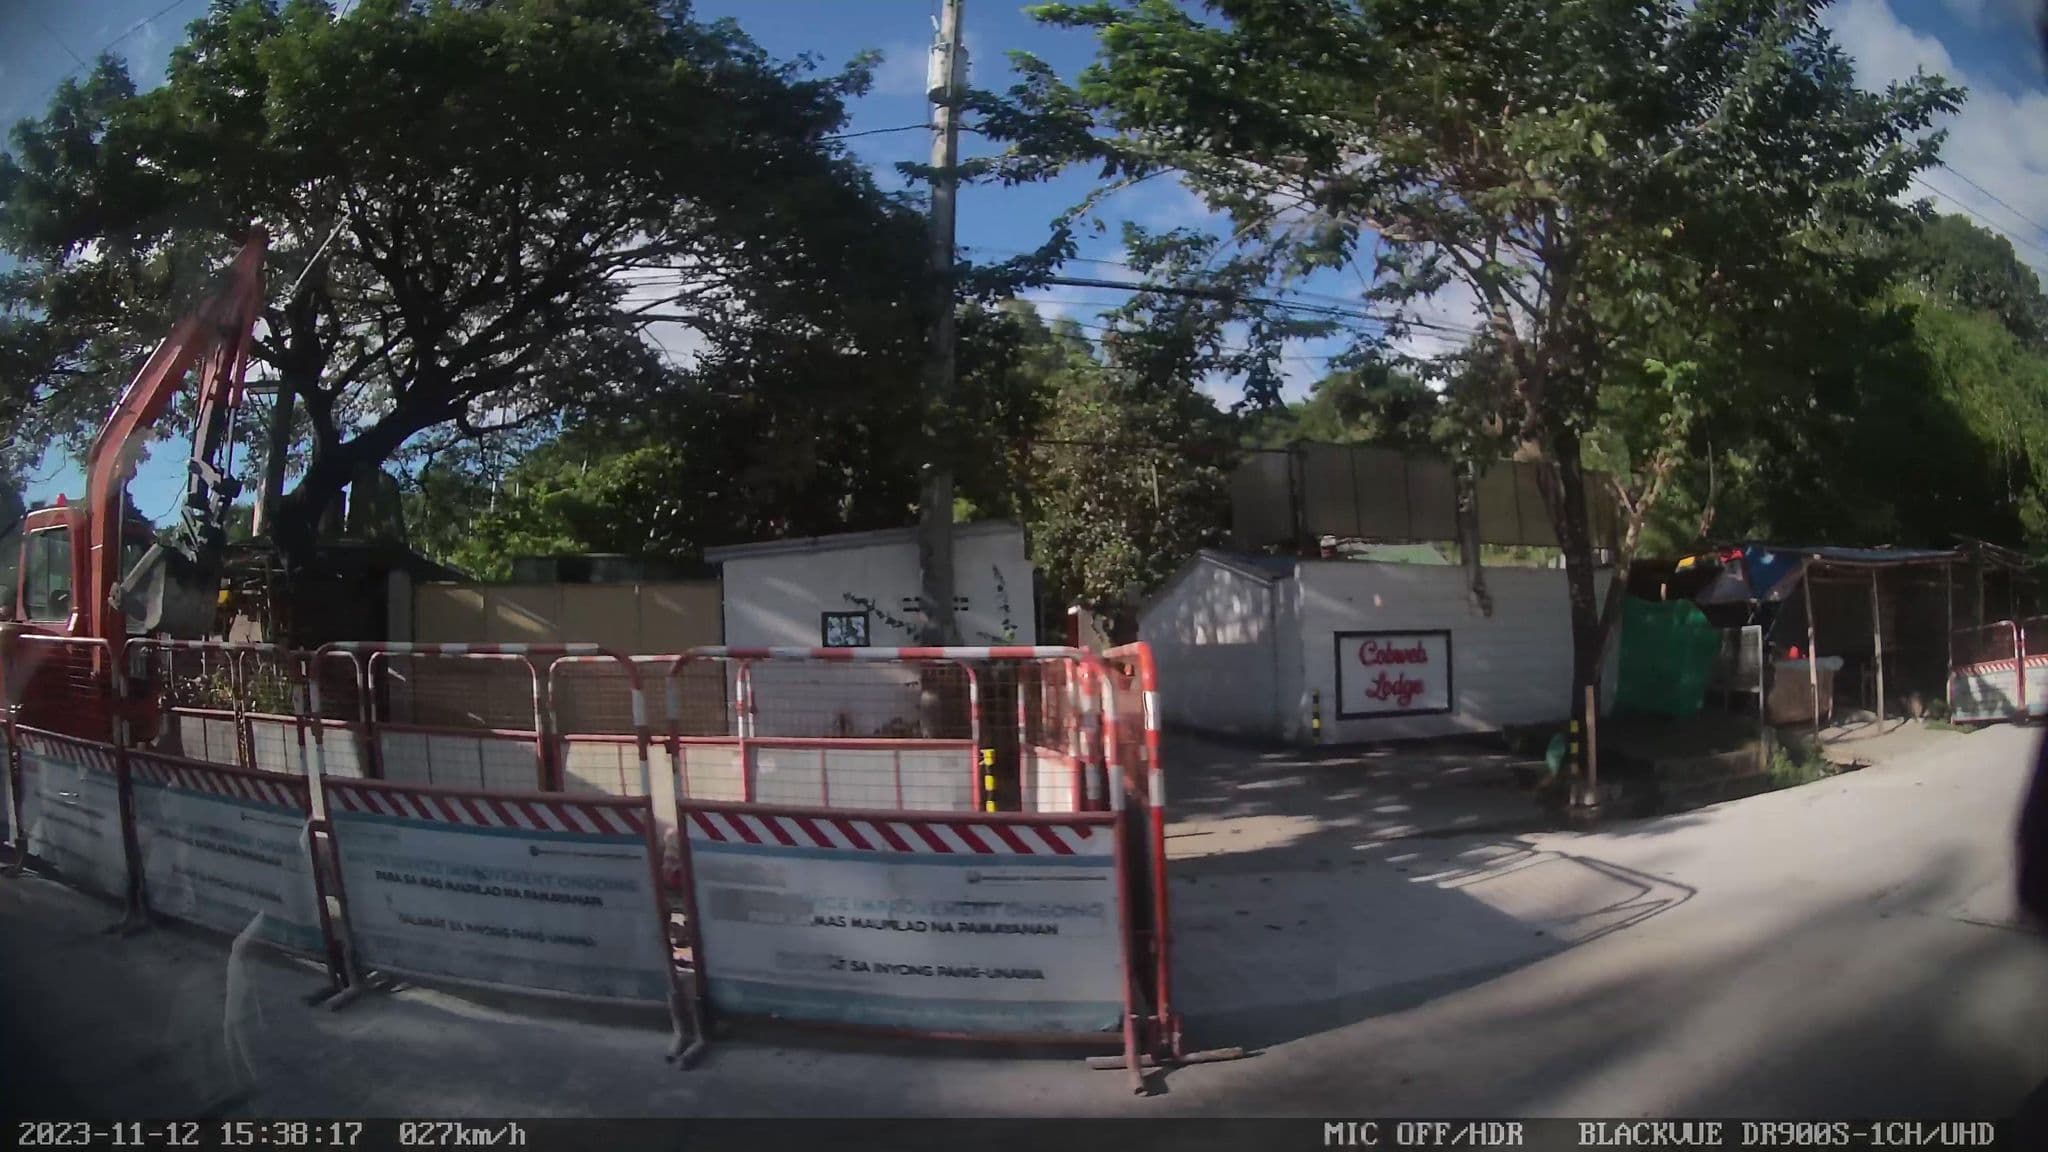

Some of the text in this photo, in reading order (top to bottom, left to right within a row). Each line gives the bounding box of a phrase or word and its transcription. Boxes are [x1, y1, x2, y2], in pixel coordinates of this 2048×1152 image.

[1359, 640, 1428, 667] Cobweb
[1365, 671, 1425, 707] Lodge
[403, 872, 417, 884] SA
[931, 921, 954, 933] NA
[850, 959, 871, 972] SA
[872, 962, 933, 976] INYONG
